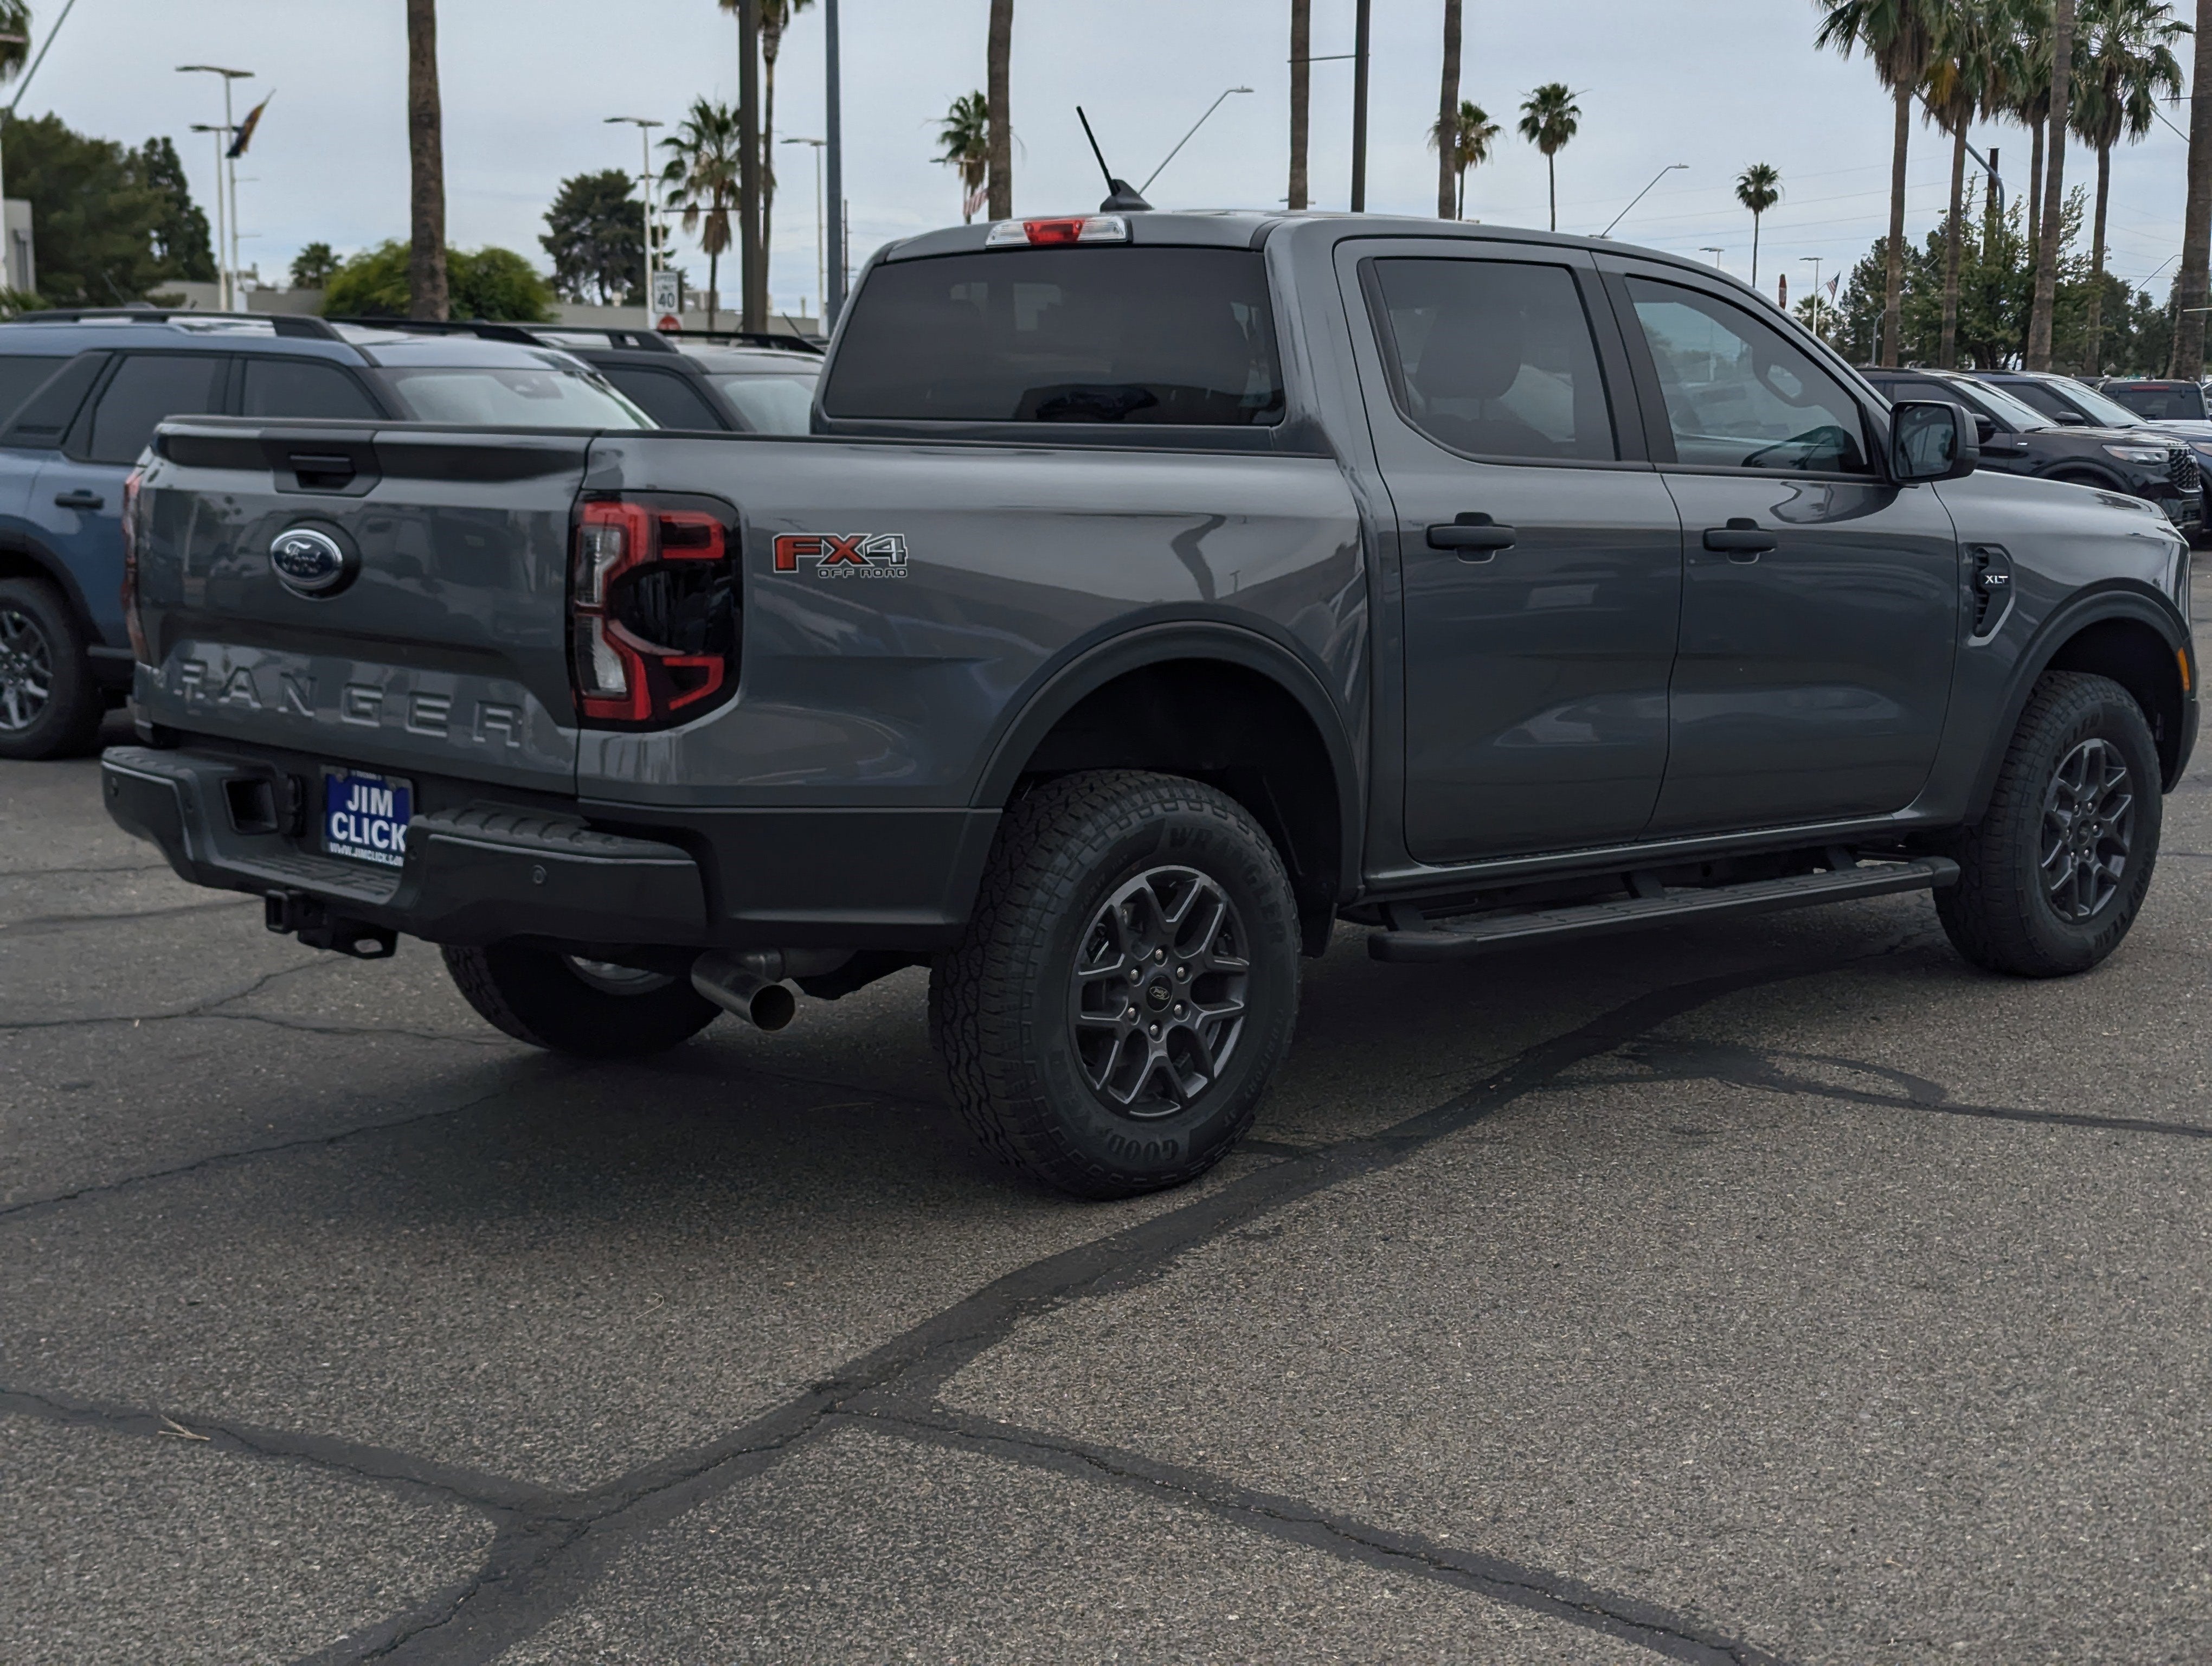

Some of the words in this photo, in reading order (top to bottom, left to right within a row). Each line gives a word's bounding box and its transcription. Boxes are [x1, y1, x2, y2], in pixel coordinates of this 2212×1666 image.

[658, 293, 675, 308] 40
[773, 533, 908, 573] FX4
[818, 568, 854, 579] OFF
[860, 568, 908, 579] ROAD
[1985, 575, 2008, 585] XLT
[174, 659, 523, 748] RANGER
[346, 784, 393, 818] JIM
[331, 811, 407, 853] CLICK
